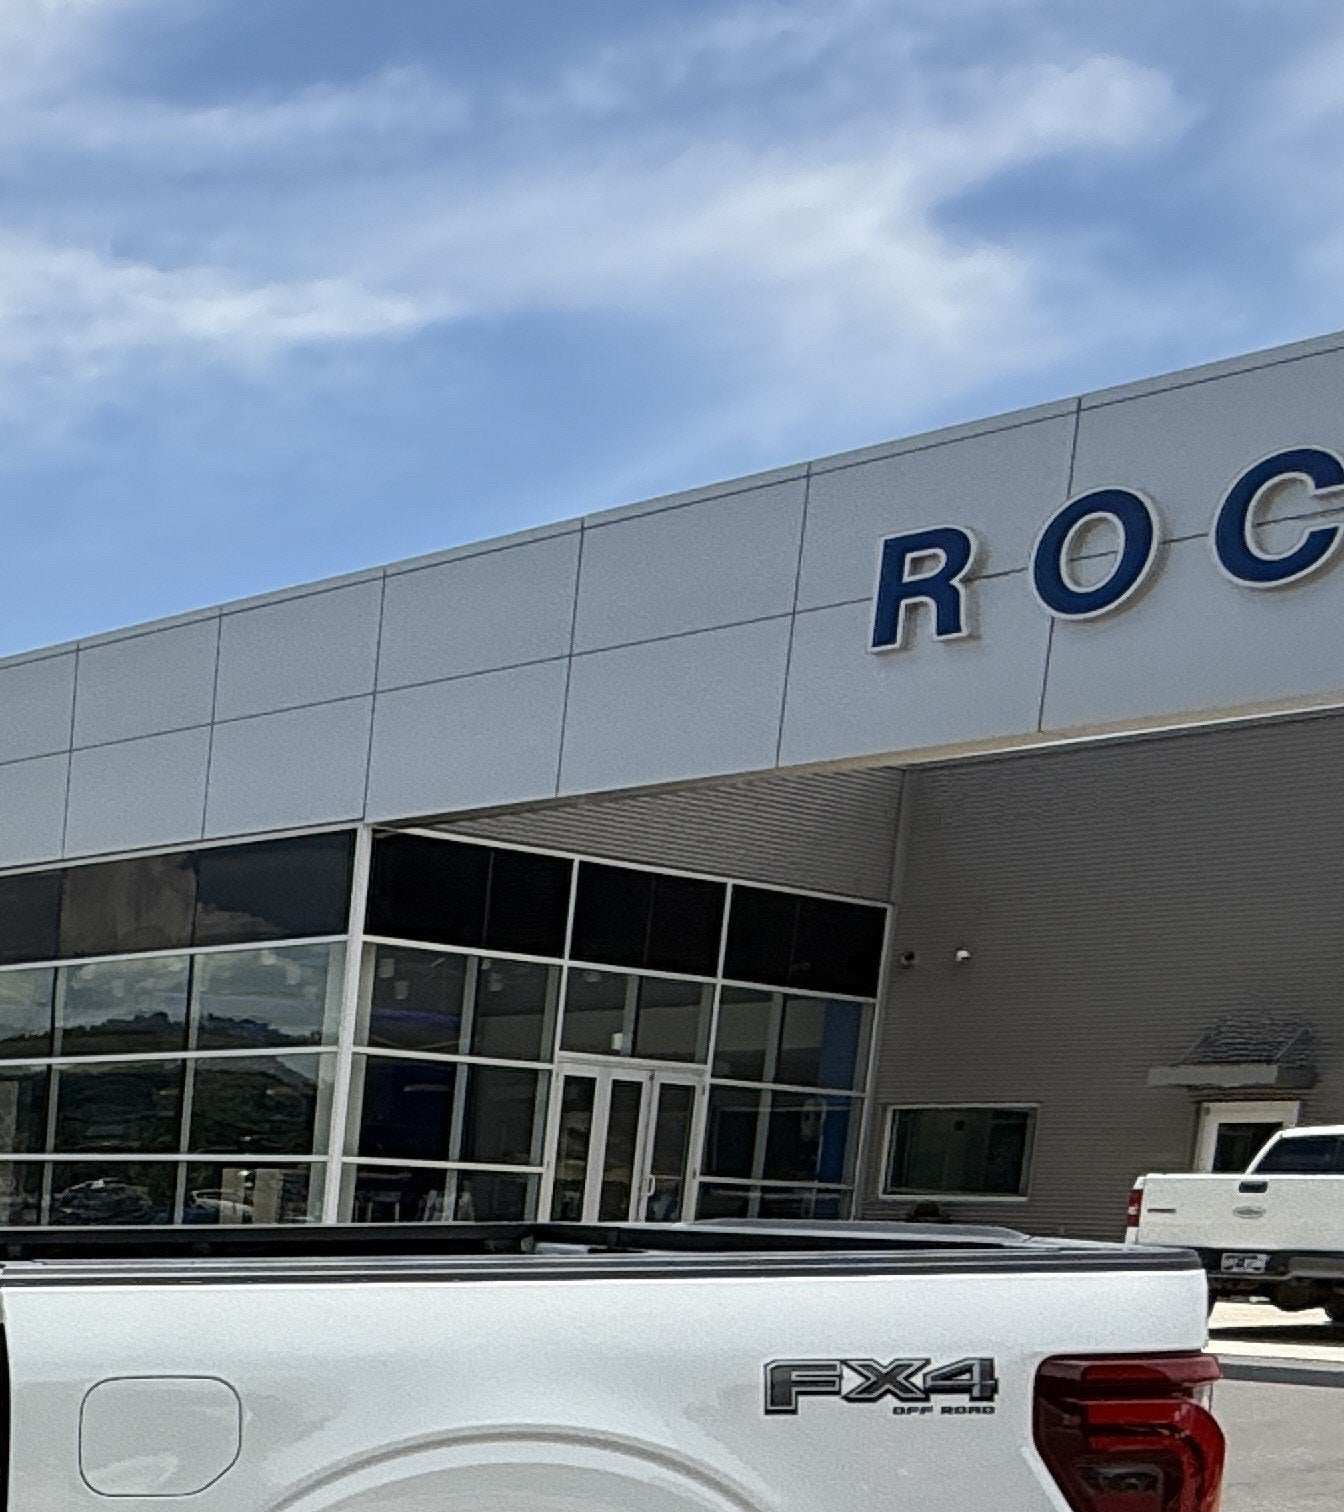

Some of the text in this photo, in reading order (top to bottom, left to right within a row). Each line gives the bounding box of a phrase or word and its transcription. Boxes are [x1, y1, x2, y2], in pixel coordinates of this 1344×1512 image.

[868, 446, 1344, 653] ROC
[763, 1357, 999, 1416] FX4
[892, 1405, 996, 1415] OFF ROAD
